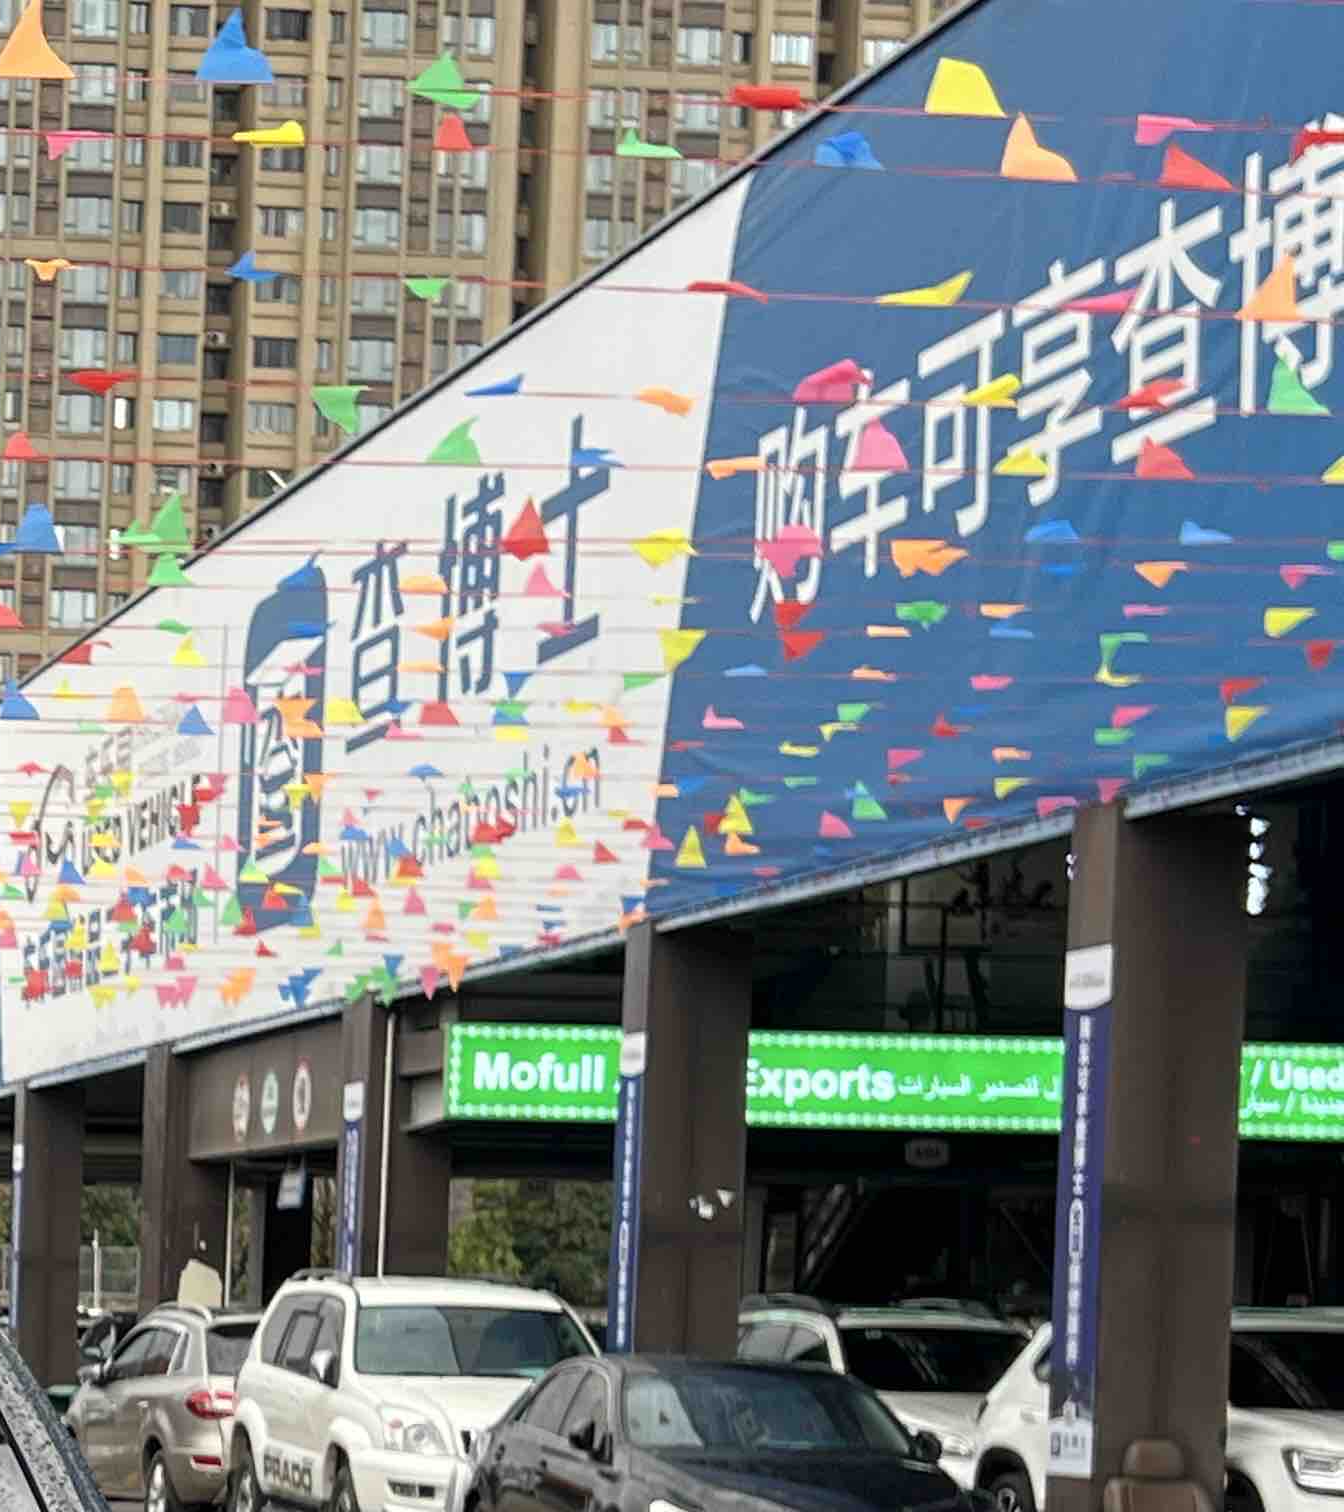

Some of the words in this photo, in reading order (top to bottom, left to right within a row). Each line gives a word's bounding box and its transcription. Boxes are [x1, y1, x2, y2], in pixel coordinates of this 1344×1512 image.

[345, 414, 610, 755] 查博士
[340, 744, 601, 888] wwwchaboshi.cn
[473, 1050, 606, 1093] Mofull
